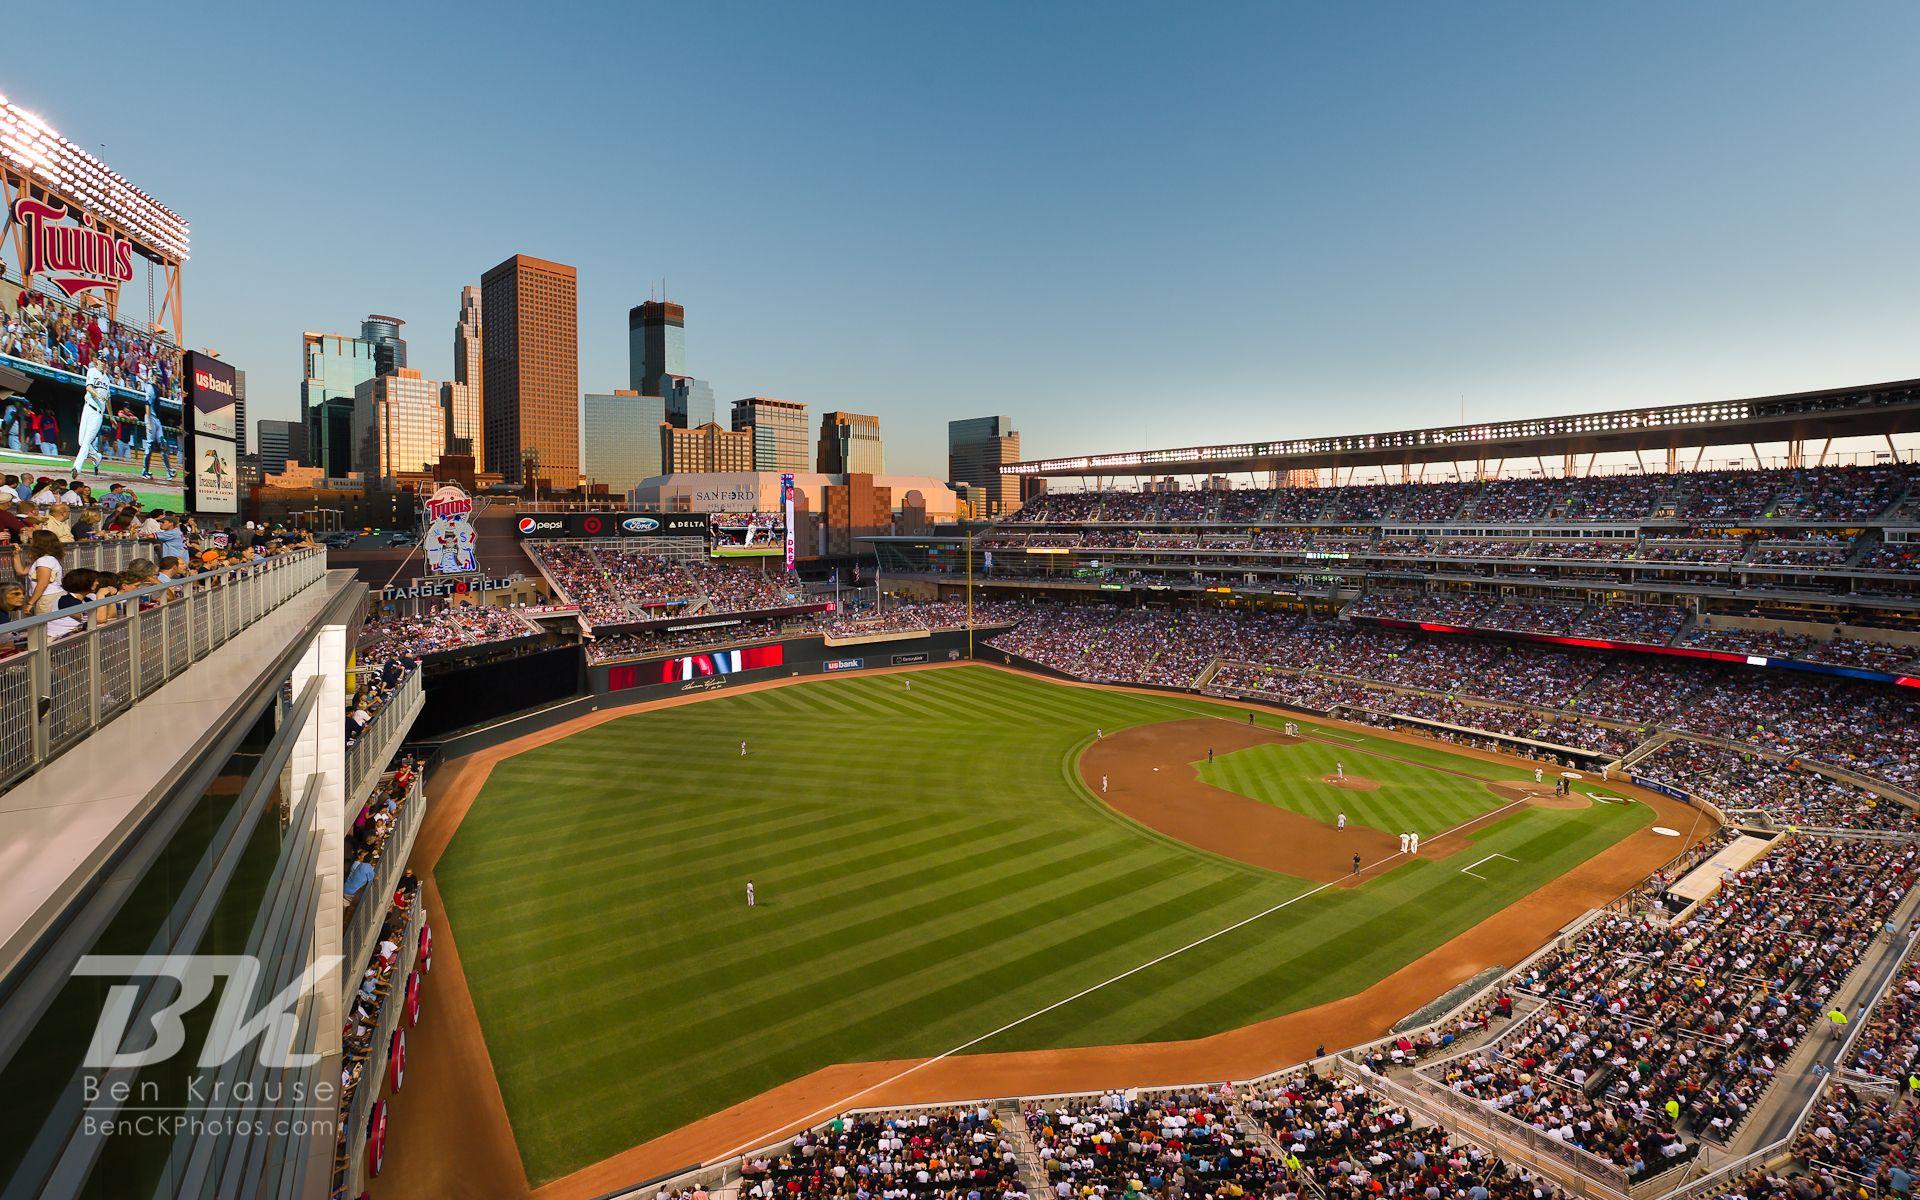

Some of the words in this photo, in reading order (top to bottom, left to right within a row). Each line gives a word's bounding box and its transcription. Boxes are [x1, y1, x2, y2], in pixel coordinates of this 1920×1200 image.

[14, 198, 133, 282] Twins
[696, 490, 754, 501] SANFORD
[425, 496, 472, 521] Twins
[537, 520, 563, 530] pepsi
[629, 518, 653, 531] Ford
[385, 583, 454, 600] TARGET
[470, 579, 512, 592] FIELD
